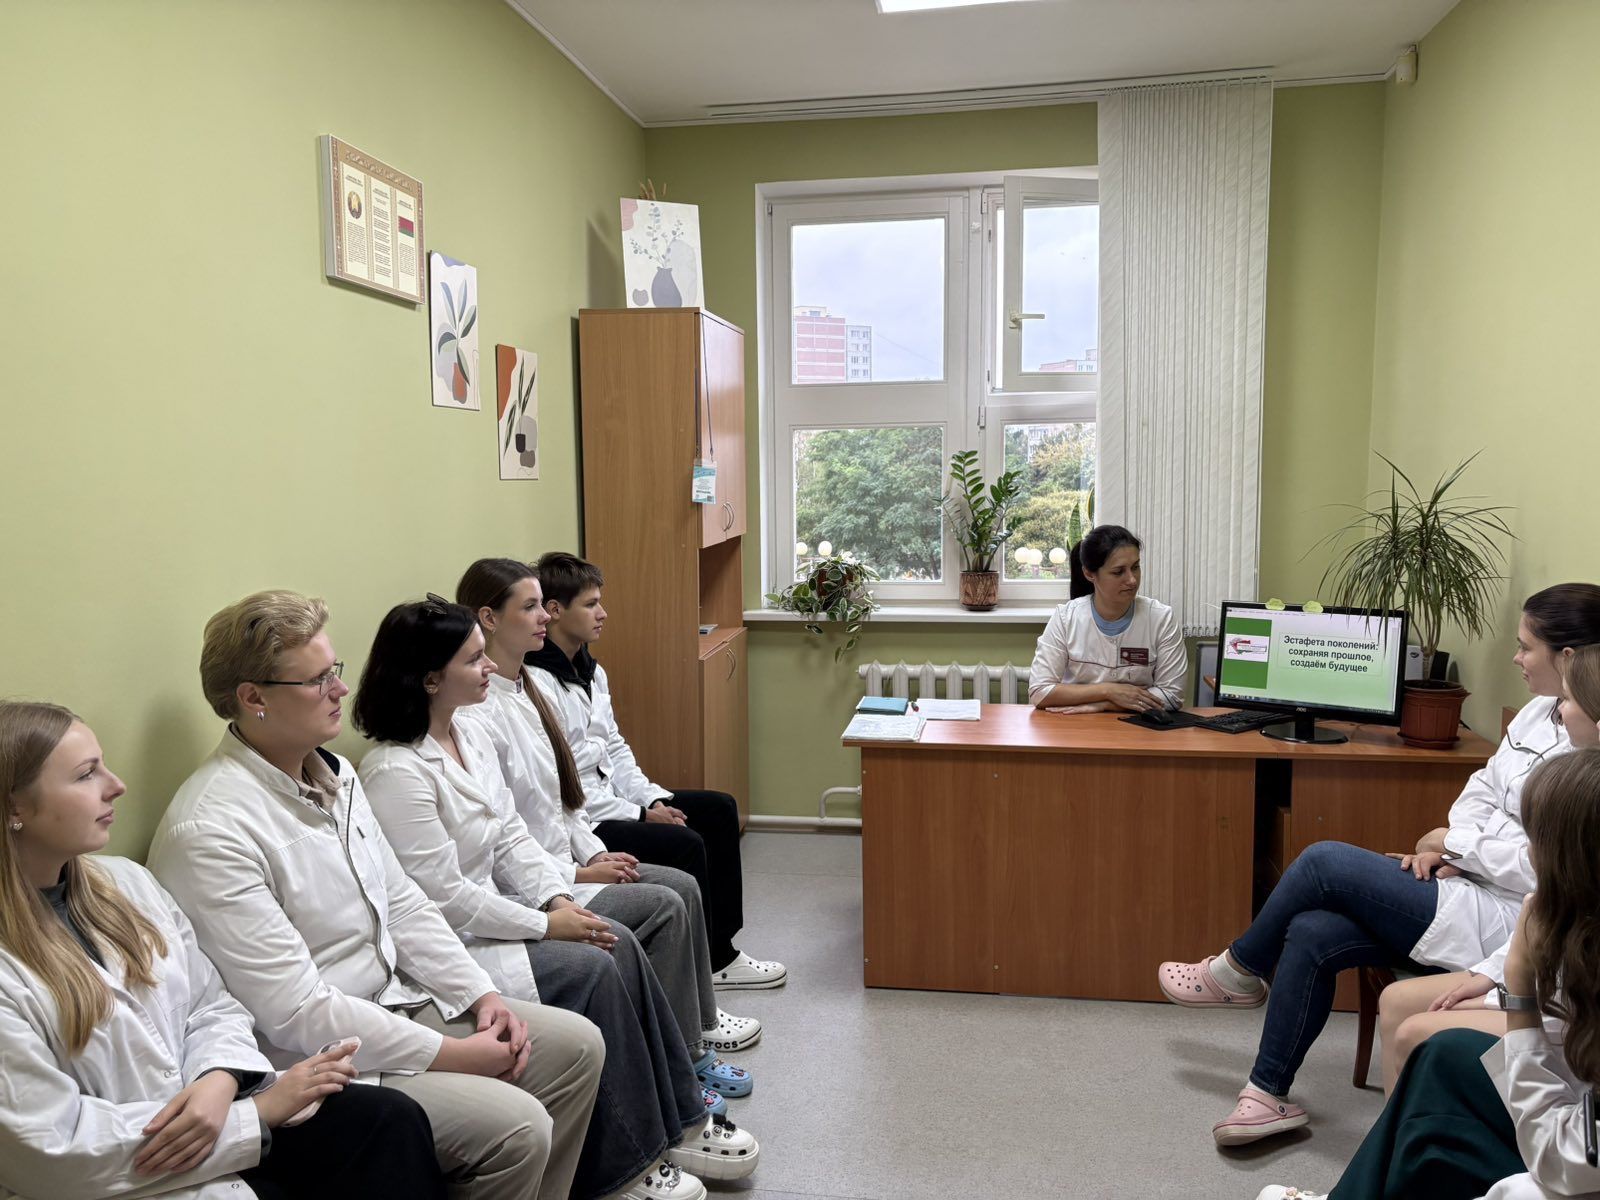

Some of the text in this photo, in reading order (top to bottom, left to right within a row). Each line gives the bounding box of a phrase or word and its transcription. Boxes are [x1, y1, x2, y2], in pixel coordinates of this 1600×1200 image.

[1284, 635, 1379, 651] Эстафета поколений:
[1288, 648, 1374, 663] сохраняя прошлое,
[1290, 659, 1368, 673] создаём будущее
